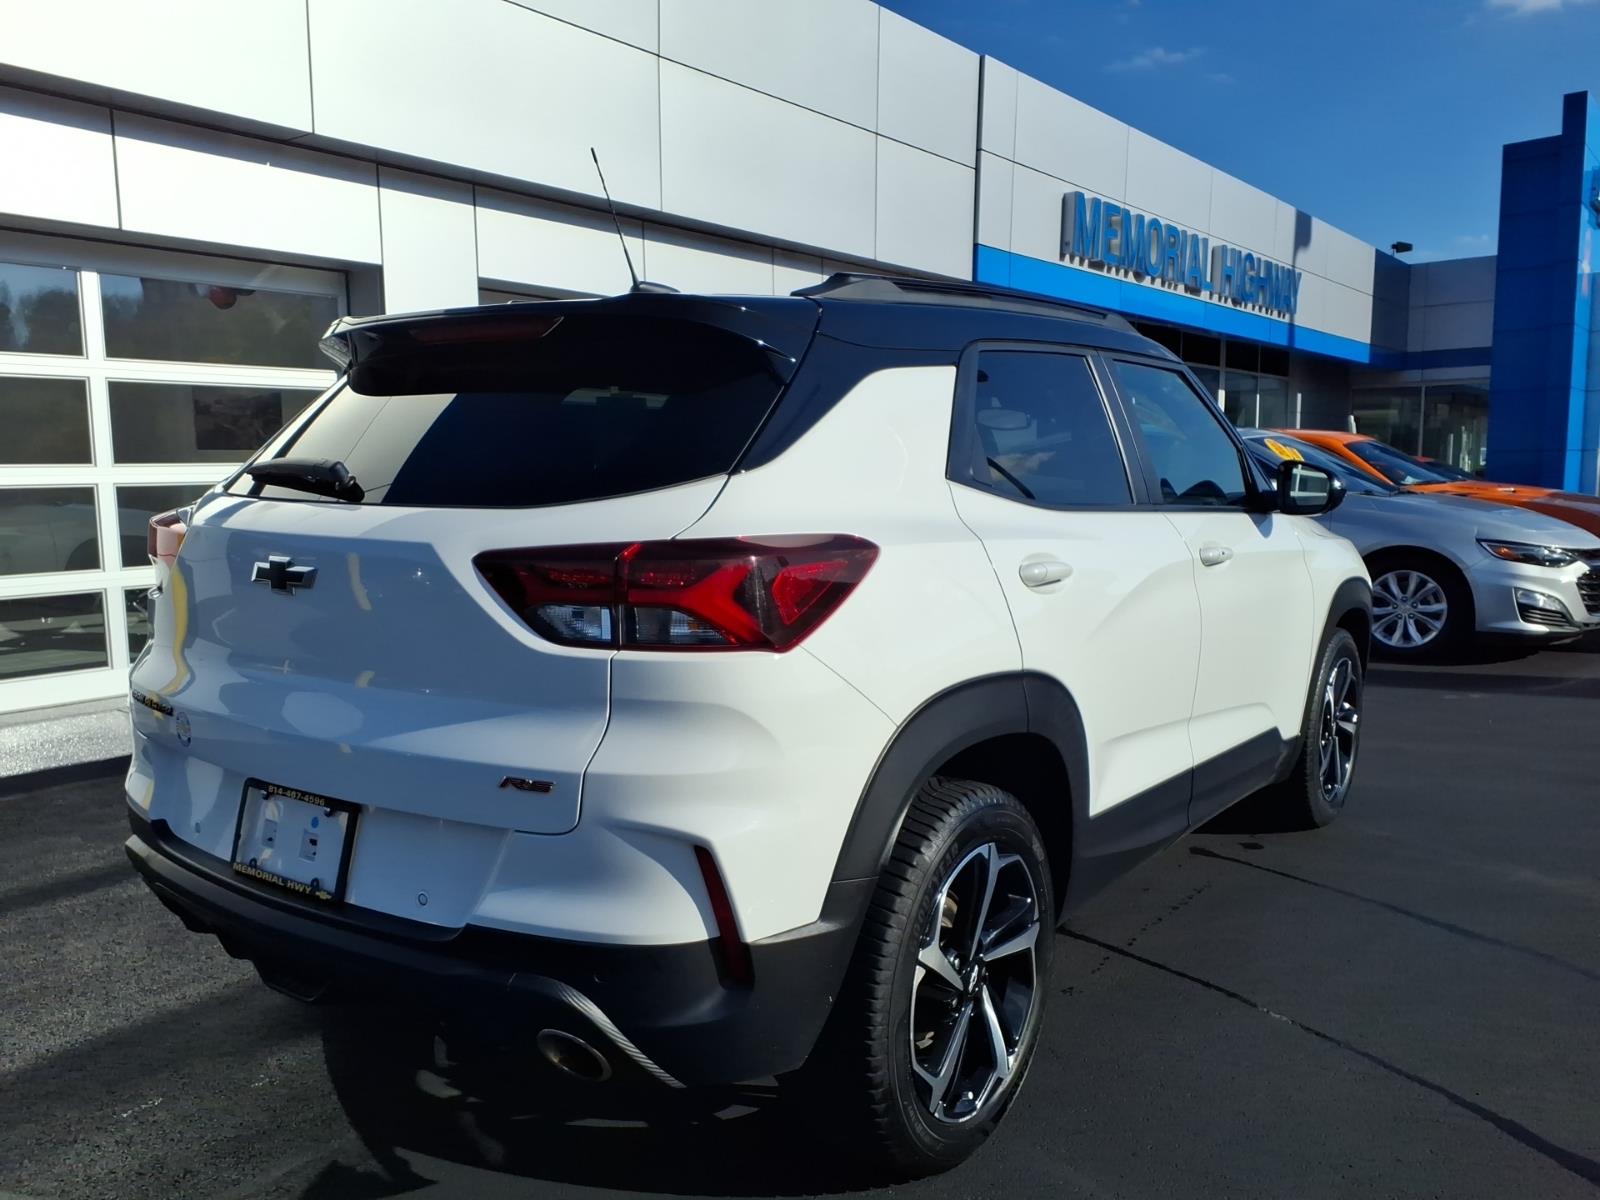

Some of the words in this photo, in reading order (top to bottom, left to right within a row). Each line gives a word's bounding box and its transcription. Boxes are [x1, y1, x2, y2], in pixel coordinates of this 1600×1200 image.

[1060, 190, 1214, 292] MEMORIAL
[1212, 243, 1302, 315] HIGHWAY
[498, 776, 556, 793] RS
[232, 862, 285, 886] MEMORIAL
[286, 880, 312, 895] HWY
